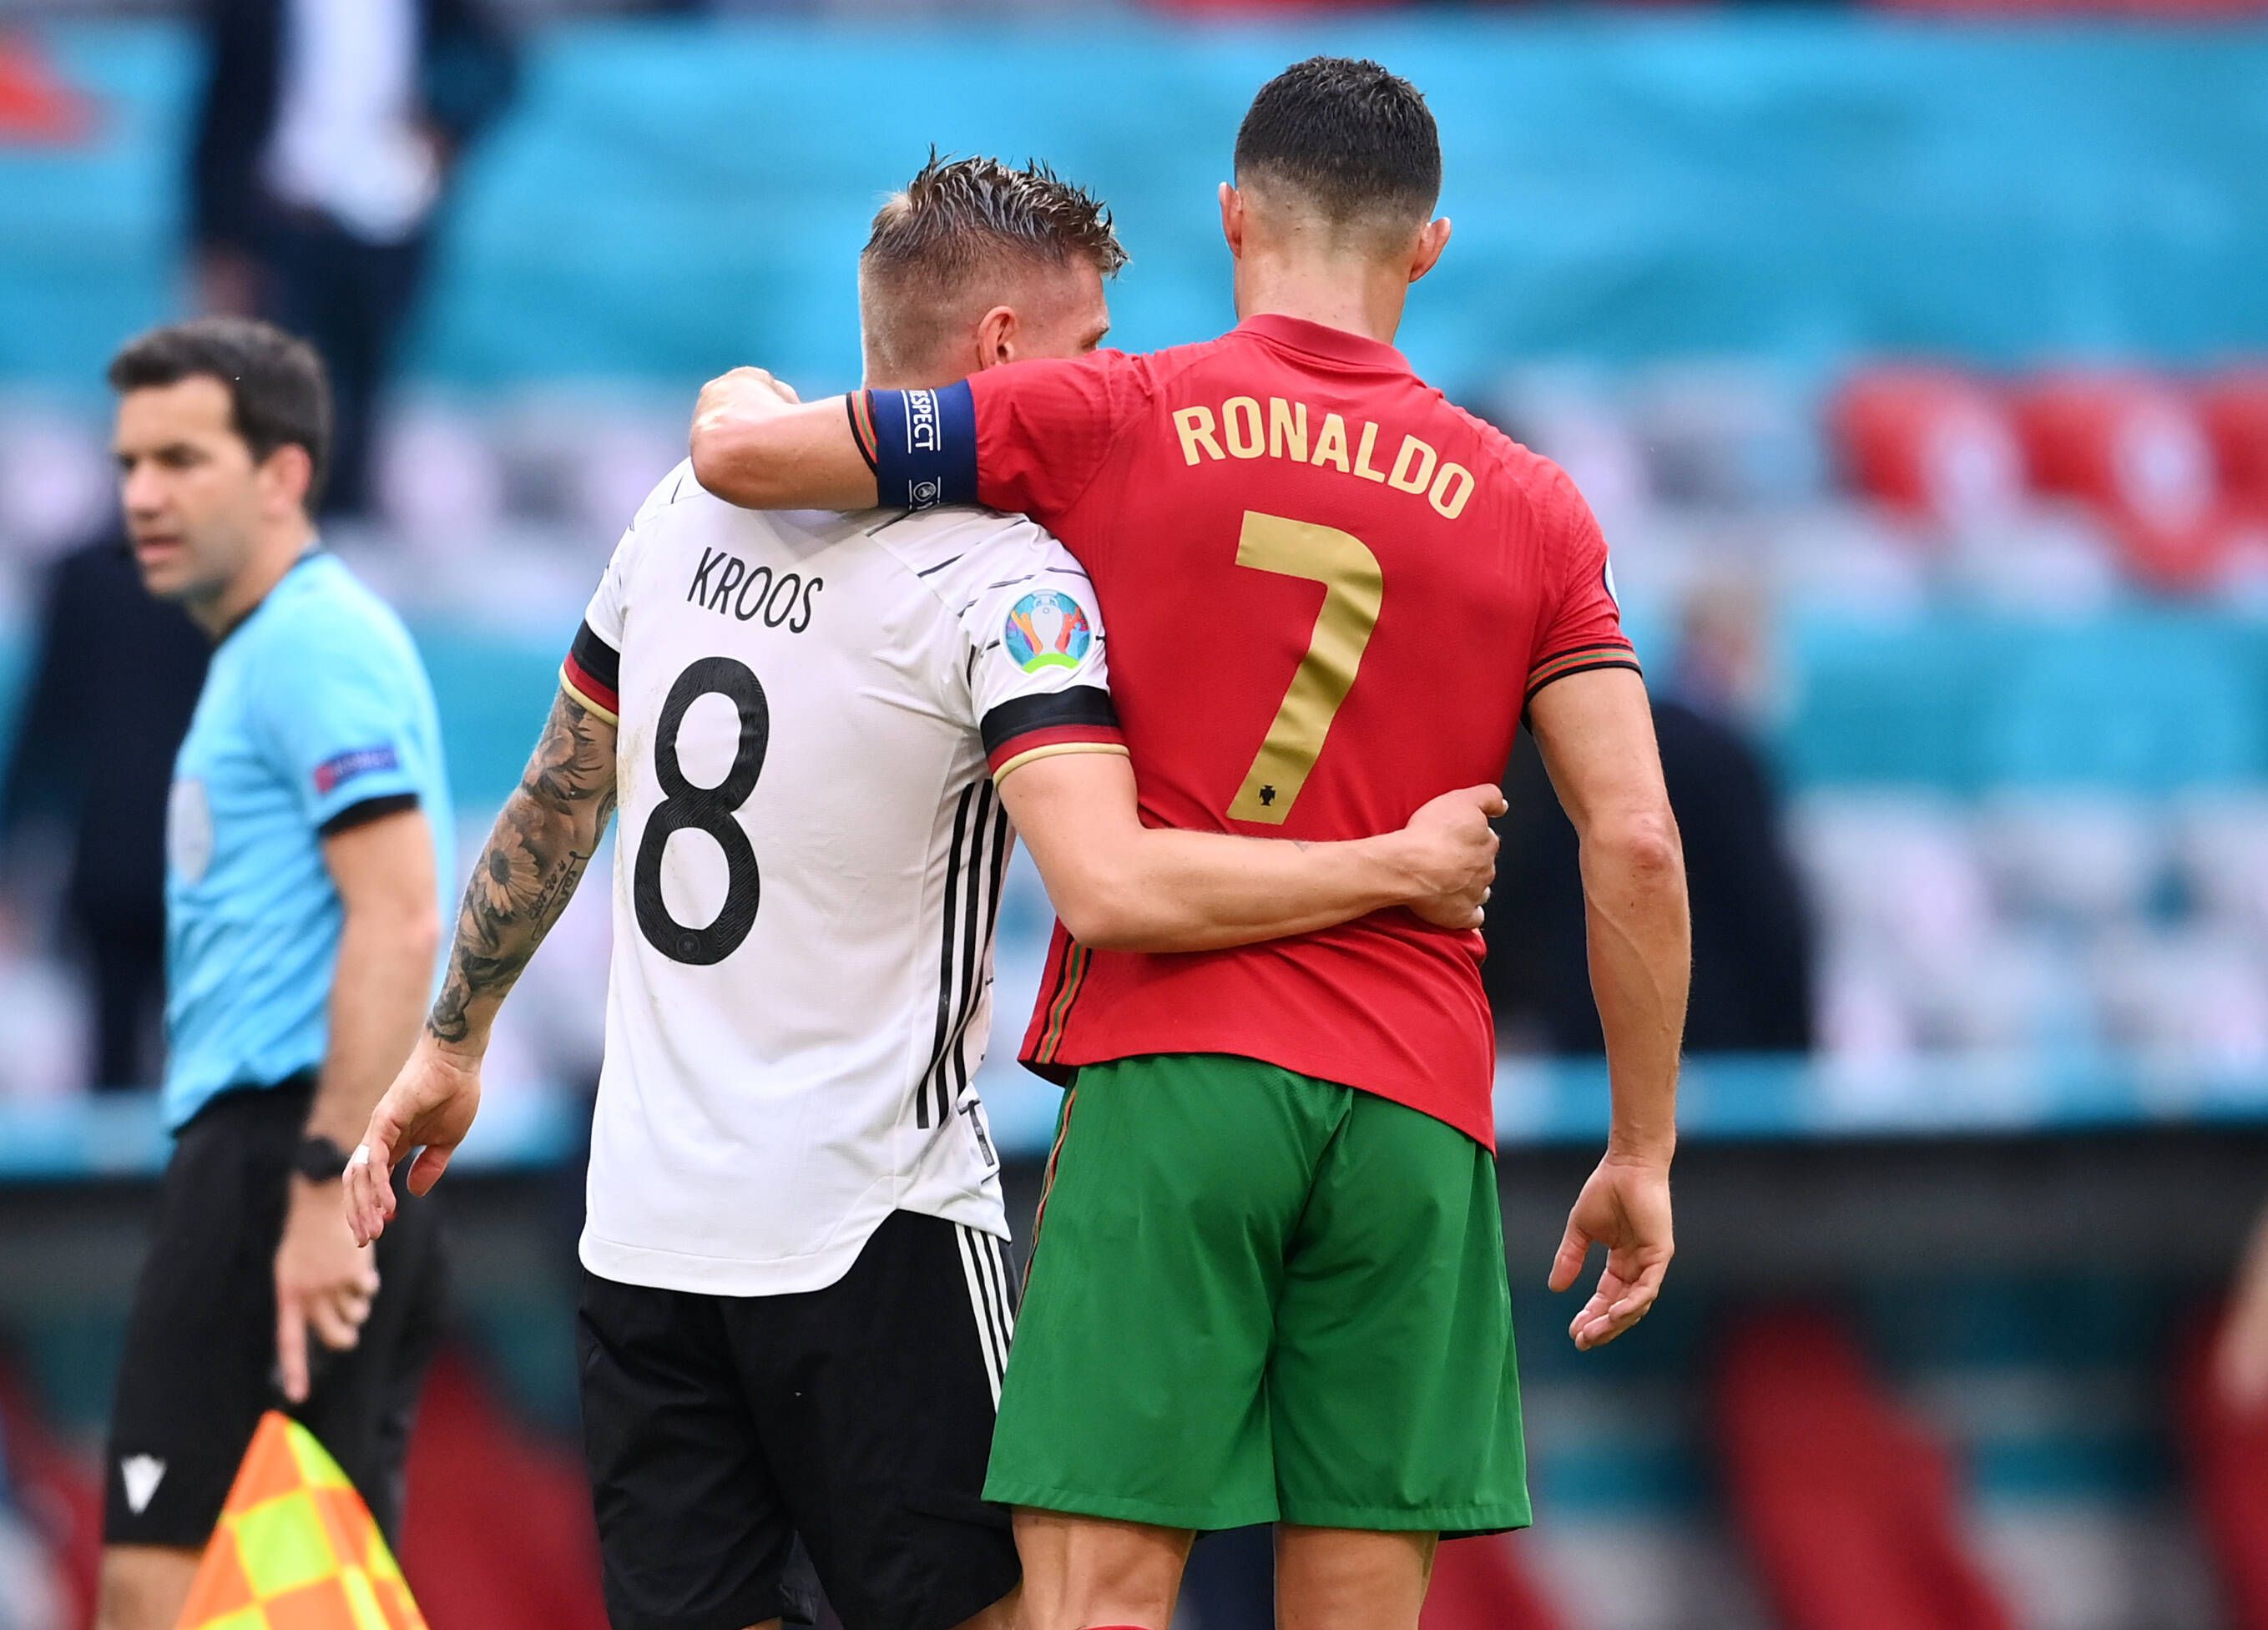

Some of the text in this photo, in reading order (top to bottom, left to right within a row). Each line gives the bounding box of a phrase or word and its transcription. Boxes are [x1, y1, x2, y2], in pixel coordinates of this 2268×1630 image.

[909, 390, 934, 452] ESPECT
[1172, 396, 1475, 520] RONALDO
[686, 547, 823, 633] KROOS
[1225, 509, 1383, 825] 7
[634, 656, 770, 966] 8
